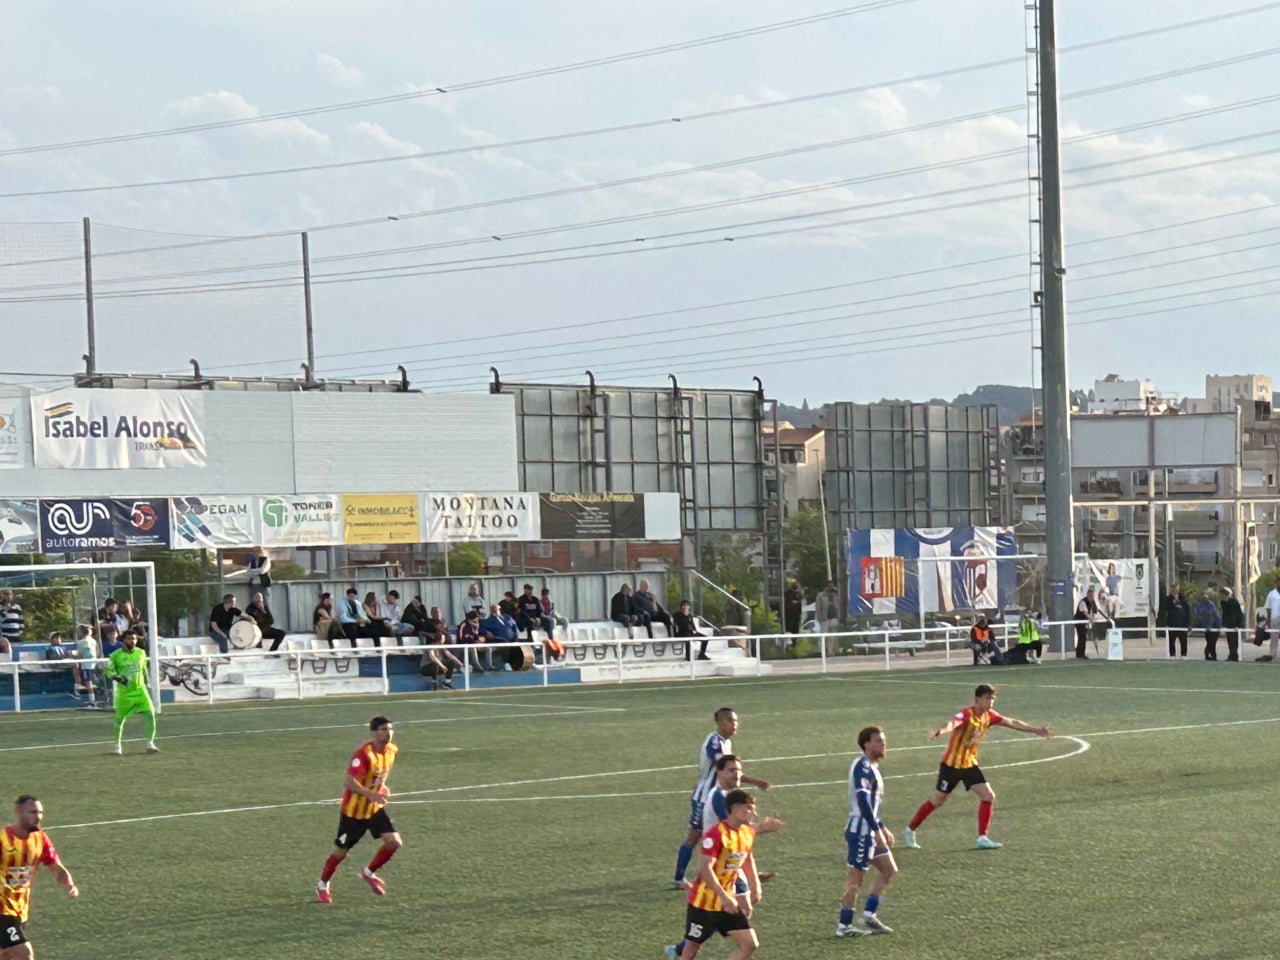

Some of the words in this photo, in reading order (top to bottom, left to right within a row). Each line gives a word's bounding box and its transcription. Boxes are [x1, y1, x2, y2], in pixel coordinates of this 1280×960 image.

[44, 415, 108, 438] Isabel
[115, 415, 188, 438] Alonso
[432, 497, 527, 511] MONTANA
[443, 514, 518, 529] TATTOO
[46, 536, 116, 548] autoramos
[7, 926, 20, 942] 2
